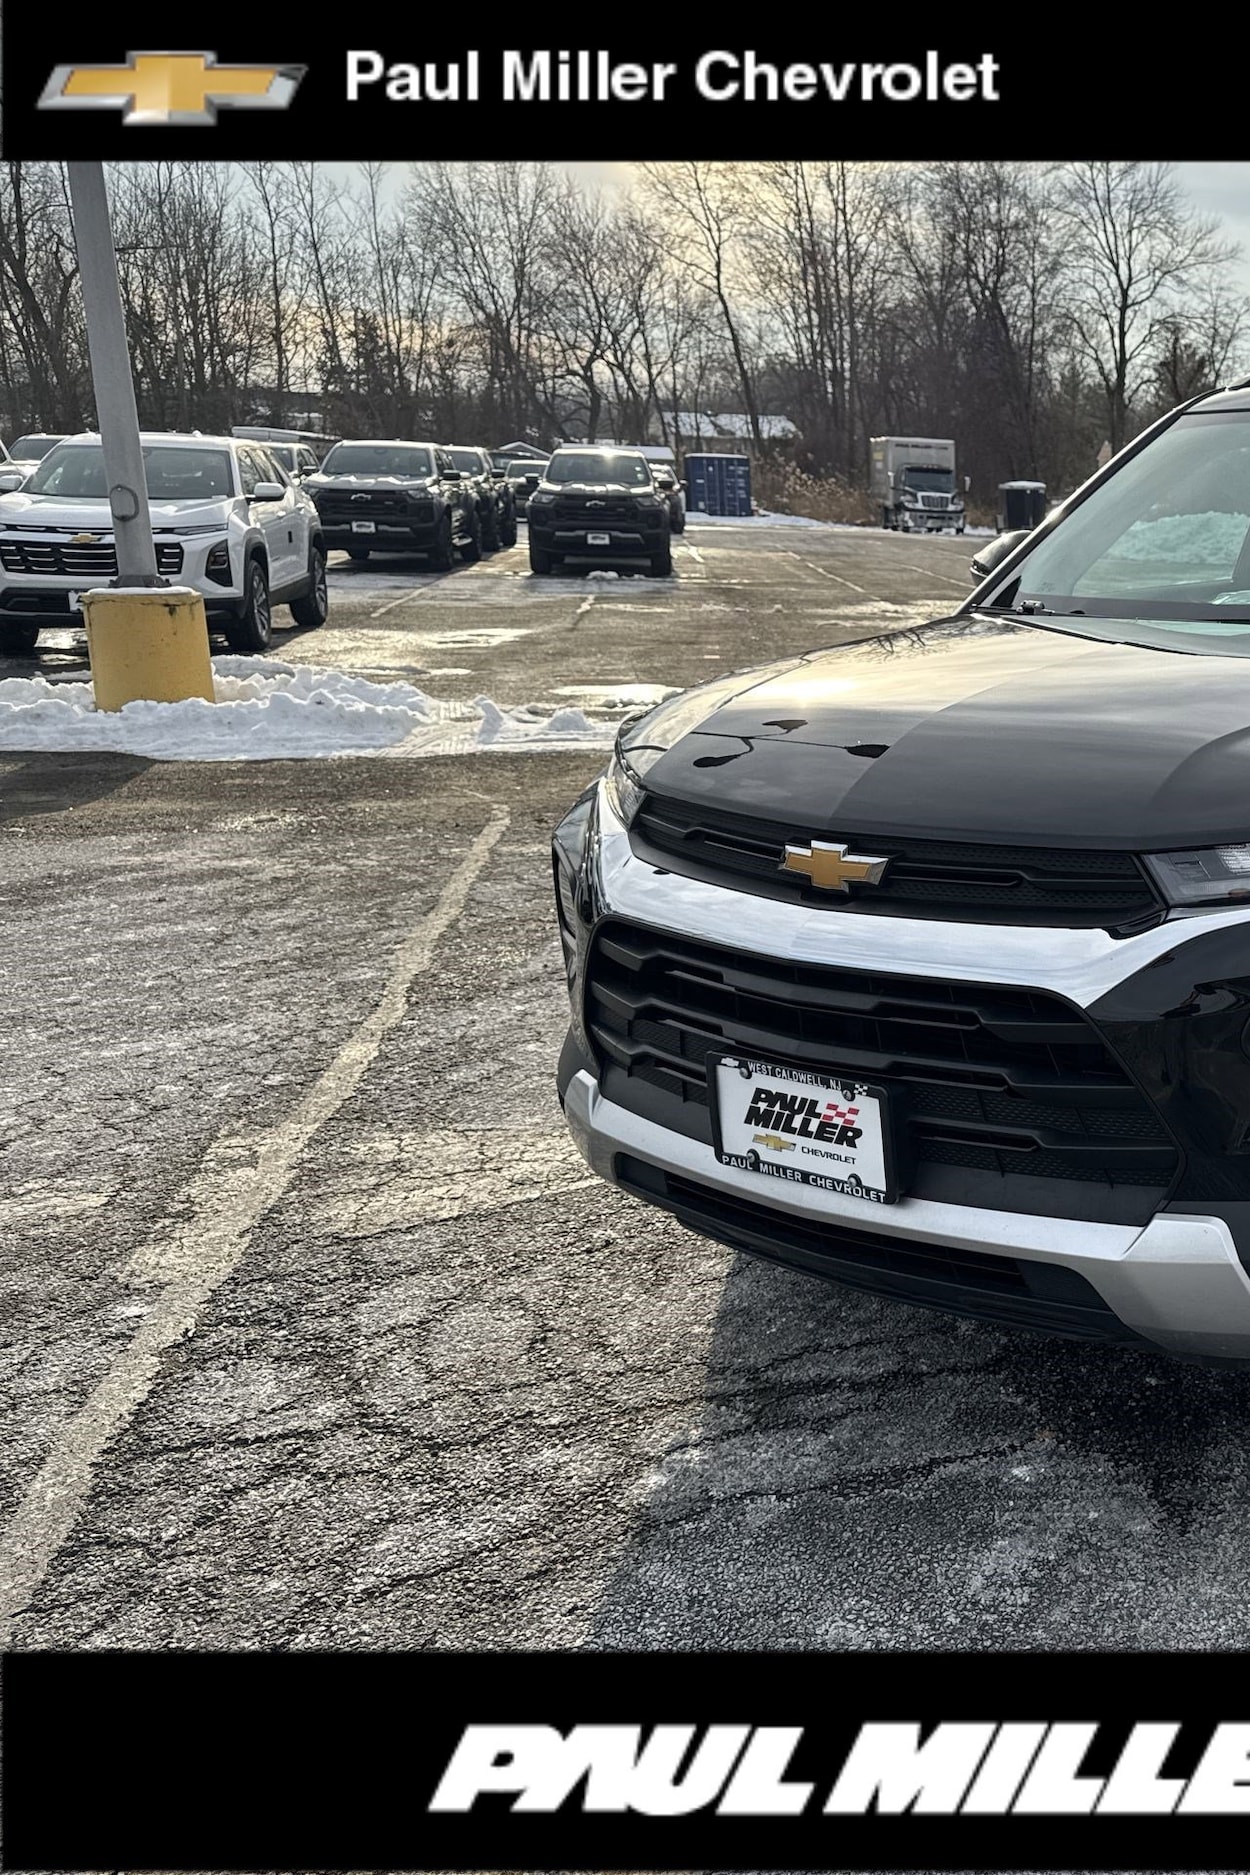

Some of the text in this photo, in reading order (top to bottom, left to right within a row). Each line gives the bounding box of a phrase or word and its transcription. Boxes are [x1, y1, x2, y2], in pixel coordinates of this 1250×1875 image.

[747, 1061, 842, 1092] WEST CALDWELL, NJ
[750, 1087, 821, 1119] PAUL
[744, 1105, 863, 1149] MILLER
[801, 1146, 856, 1165] CHEVROLET
[722, 1155, 886, 1203] PAUL MILLER CHEVROLET
